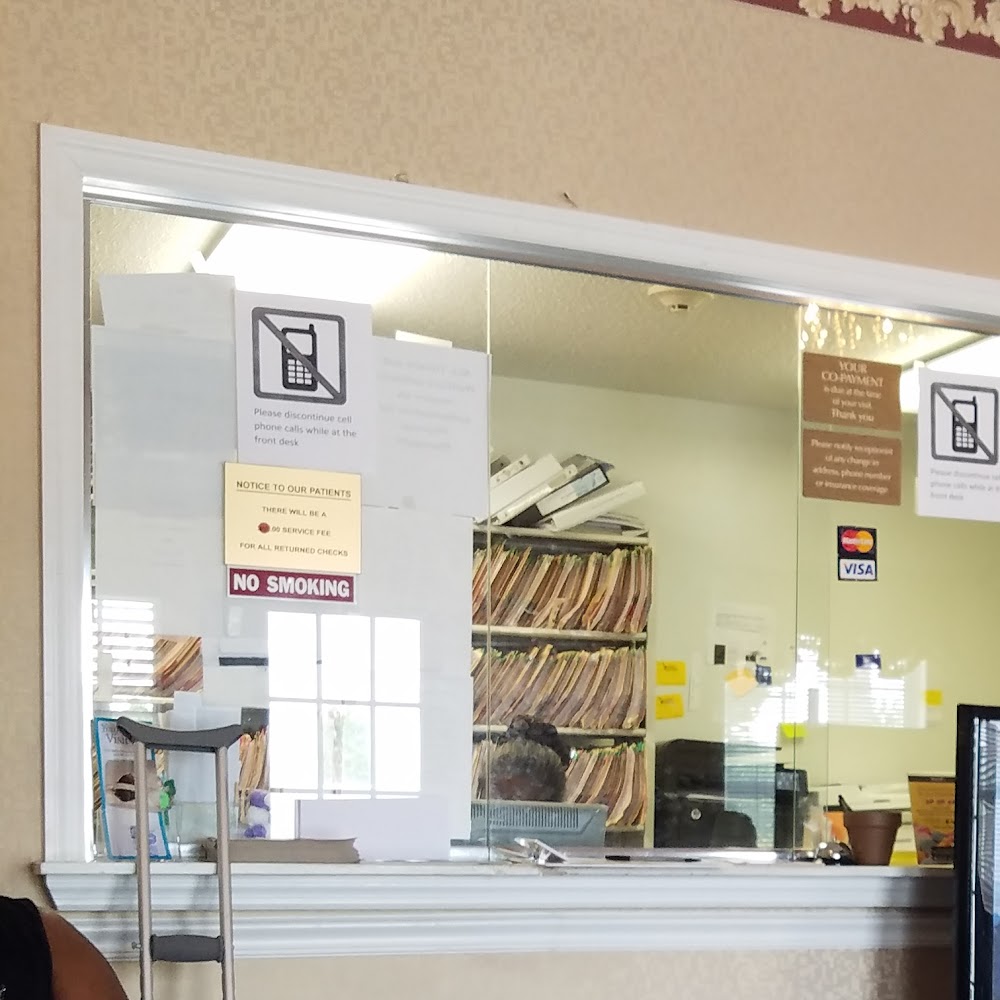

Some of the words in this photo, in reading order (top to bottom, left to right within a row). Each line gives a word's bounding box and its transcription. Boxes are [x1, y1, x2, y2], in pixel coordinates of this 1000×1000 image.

[839, 361, 868, 373] YOUR
[853, 388, 866, 397] the
[841, 399, 857, 408] your
[254, 408, 282, 418] Please
[284, 411, 335, 423] discontinue
[337, 416, 352, 424] cell
[831, 408, 857, 420] Thank
[858, 414, 875, 423] you
[254, 422, 282, 431] phone
[284, 424, 304, 434] calls
[305, 427, 329, 435] while
[331, 429, 340, 437] at
[342, 429, 357, 438] the
[254, 435, 276, 445] front
[279, 438, 299, 446] desk
[236, 481, 270, 491] NOTICE
[273, 484, 285, 492] TO
[287, 485, 307, 494] OUR
[309, 487, 352, 498] PATIENTS
[262, 506, 287, 514] THERE
[289, 508, 307, 516] WILL
[282, 527, 315, 535] SERVICE
[240, 542, 256, 550] FOR
[274, 545, 315, 554] RETURNED
[317, 548, 348, 557] CHECKS
[844, 563, 873, 576] VISA
[233, 573, 259, 592] NO
[266, 575, 350, 598] SMOKING
